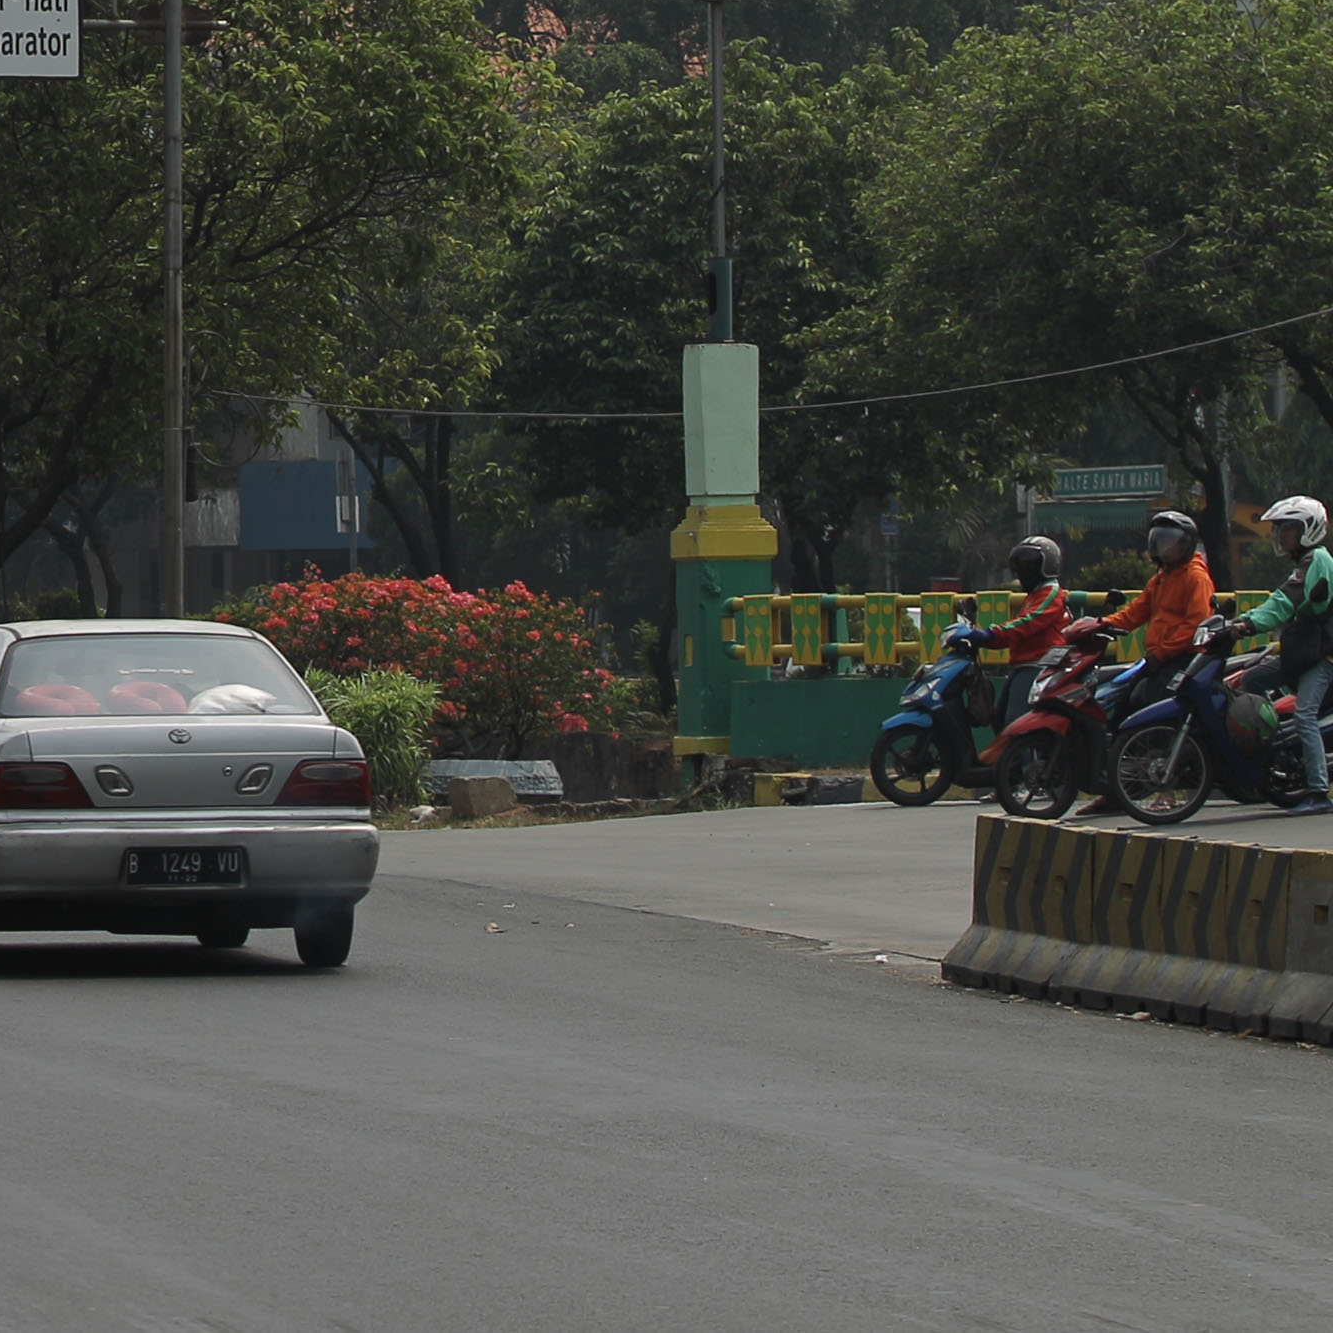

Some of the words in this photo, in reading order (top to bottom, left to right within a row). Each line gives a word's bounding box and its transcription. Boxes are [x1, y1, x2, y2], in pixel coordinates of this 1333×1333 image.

[1093, 473, 1126, 490] SANTA
[129, 853, 139, 874] B
[161, 852, 201, 872] 1249
[217, 852, 238, 872] VU
